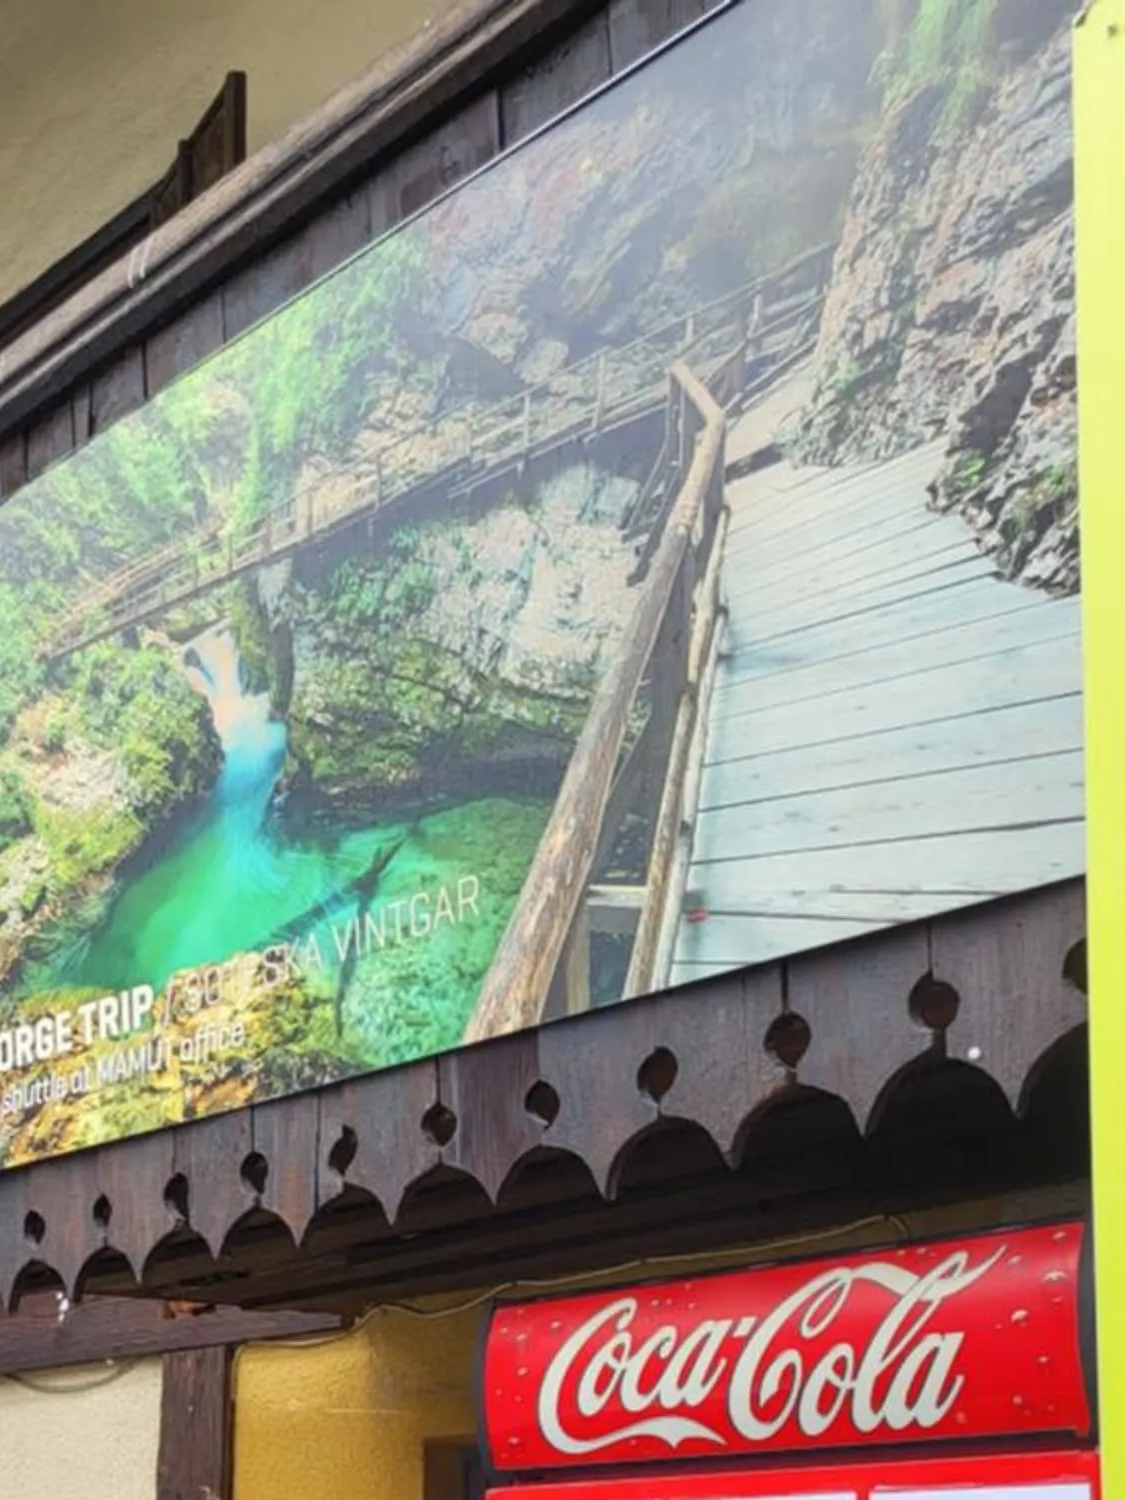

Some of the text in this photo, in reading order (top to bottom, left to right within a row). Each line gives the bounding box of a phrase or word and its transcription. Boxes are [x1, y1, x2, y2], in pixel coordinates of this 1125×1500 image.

[78, 984, 154, 1046] TRIP
[331, 874, 481, 962] VINTGAR
[2, 1074, 68, 1114] shuttle
[70, 1069, 90, 1096] at
[95, 1036, 172, 1081] MAMUT
[178, 1018, 247, 1063] office
[538, 1244, 1007, 1454] Coca-Cola
